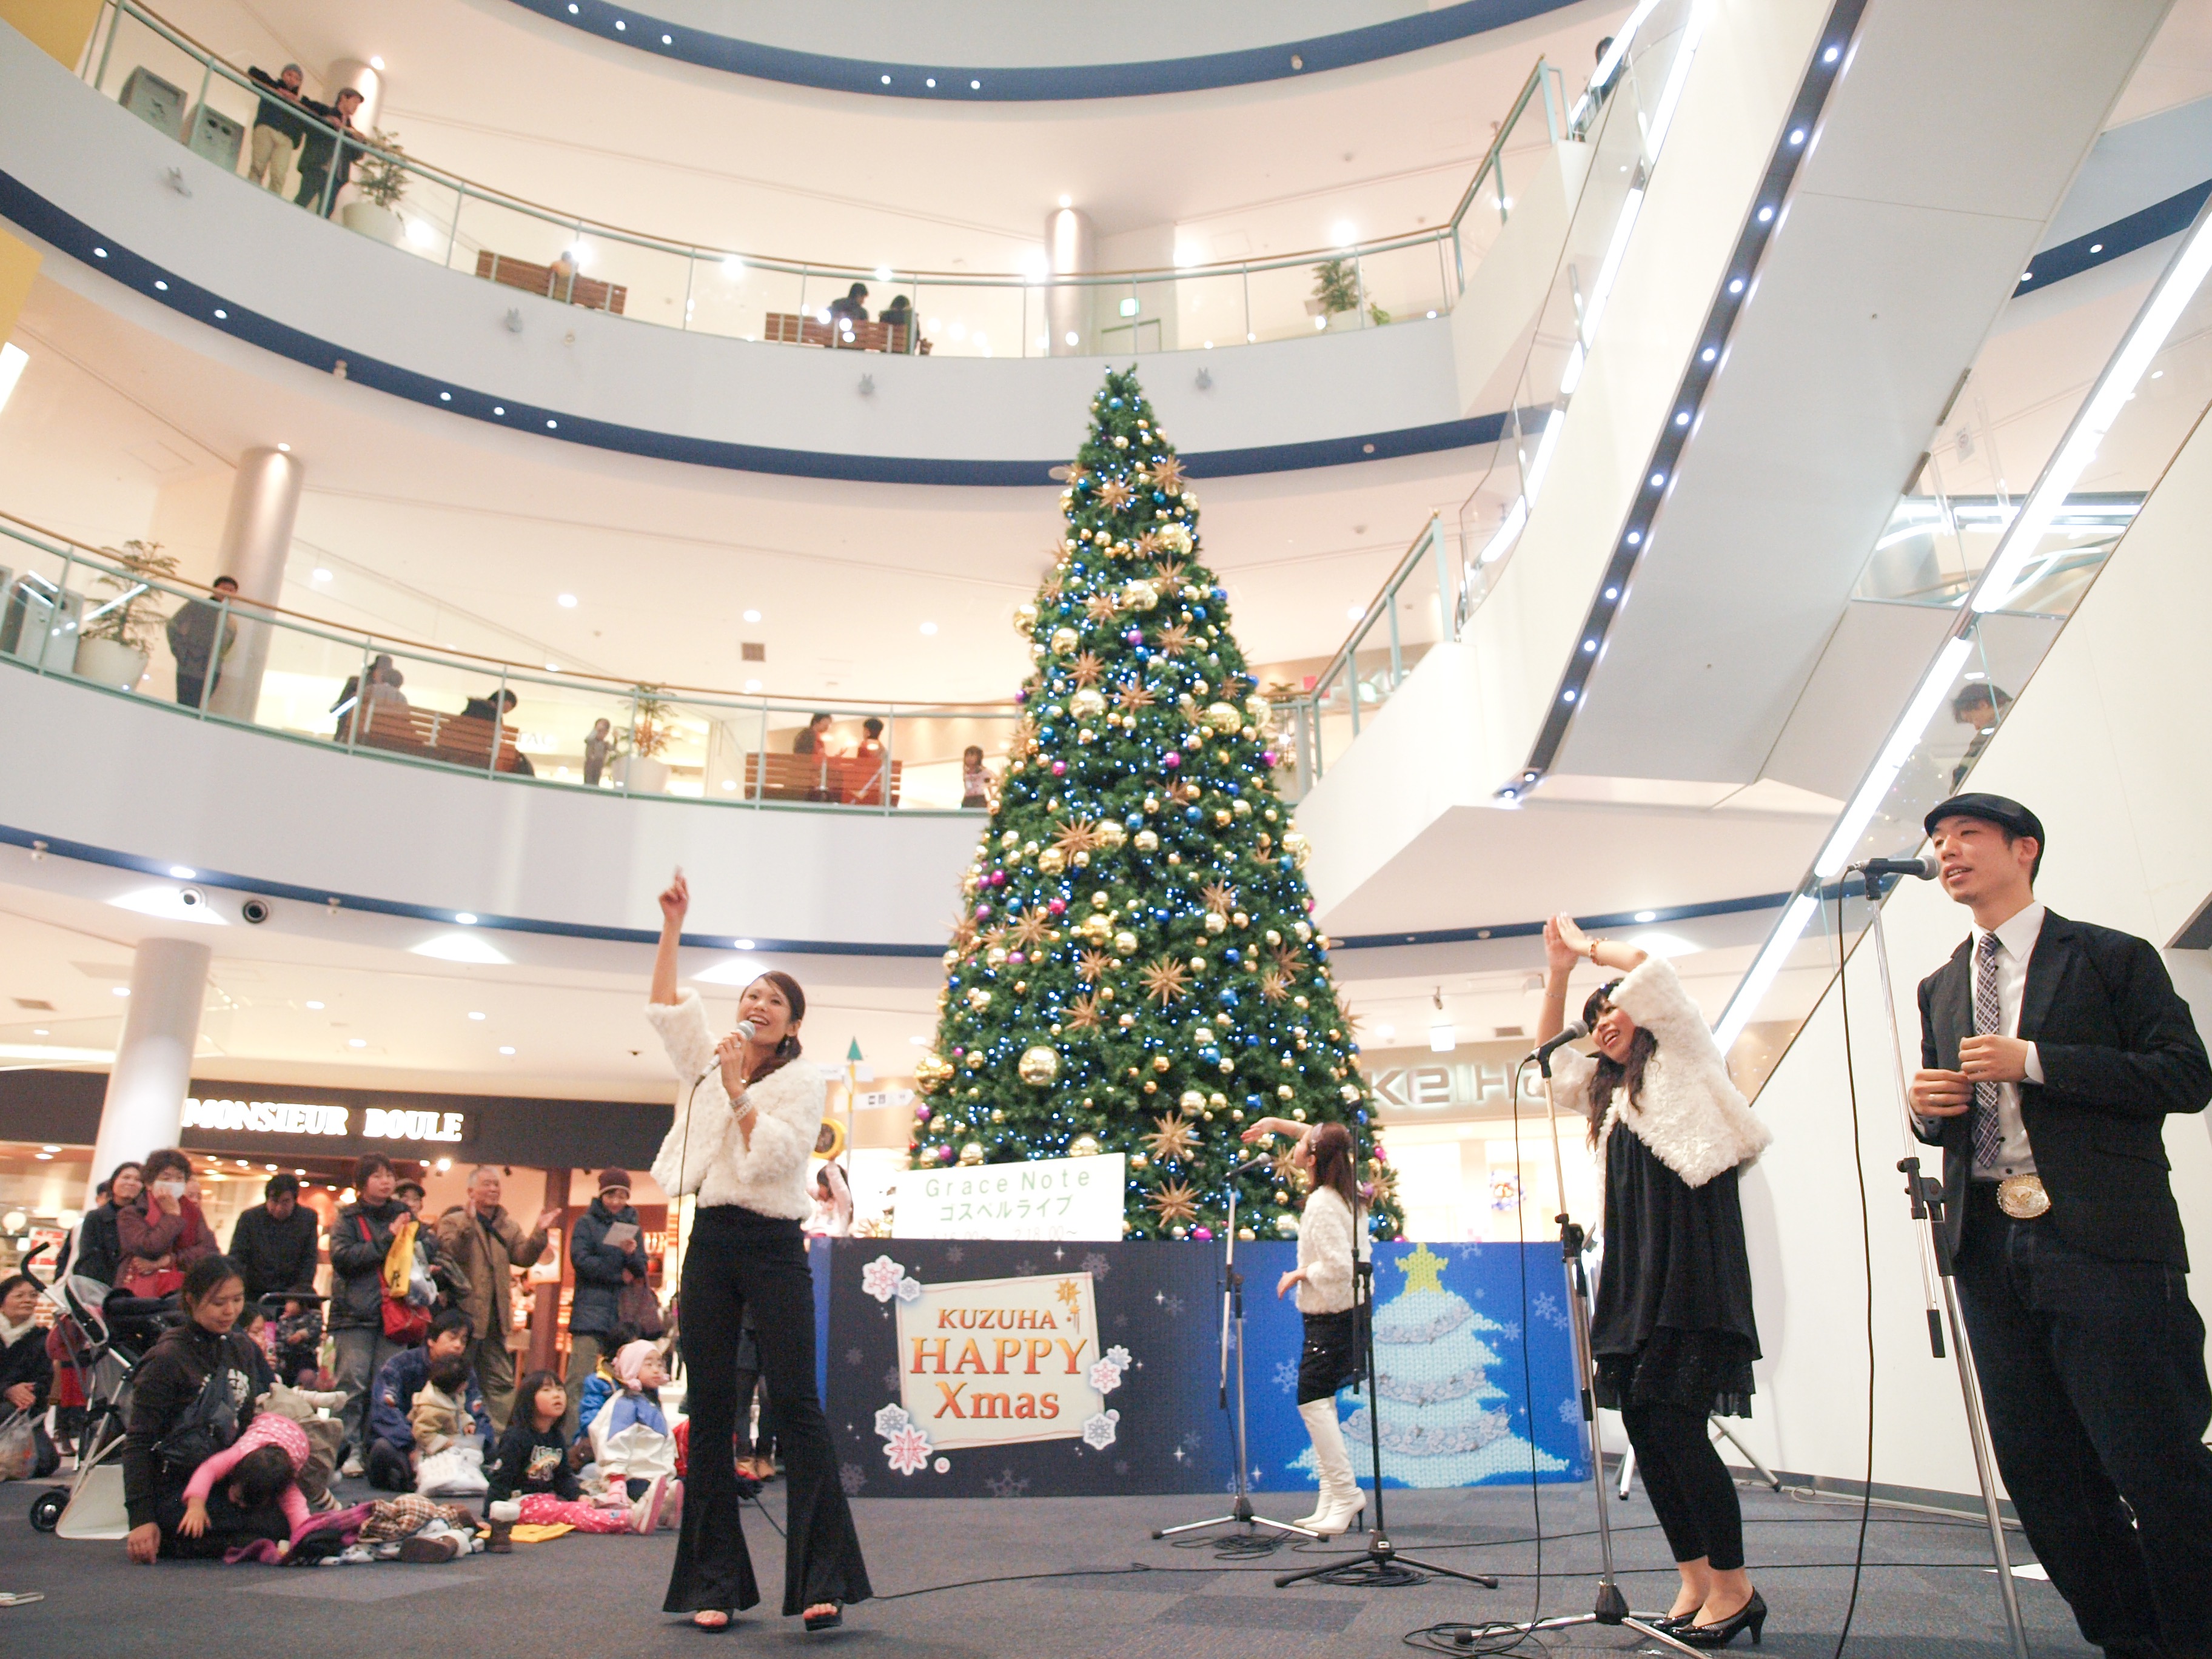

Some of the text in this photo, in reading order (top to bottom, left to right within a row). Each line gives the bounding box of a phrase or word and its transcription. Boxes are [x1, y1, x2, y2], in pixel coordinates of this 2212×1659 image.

[182, 1098, 464, 1142] MONSIEUR BOULE
[926, 1169, 1090, 1198] Grace Note
[938, 1309, 1058, 1329] KUZUHA
[910, 1337, 1087, 1374] HAPPY
[934, 1381, 1059, 1419] Xmas
